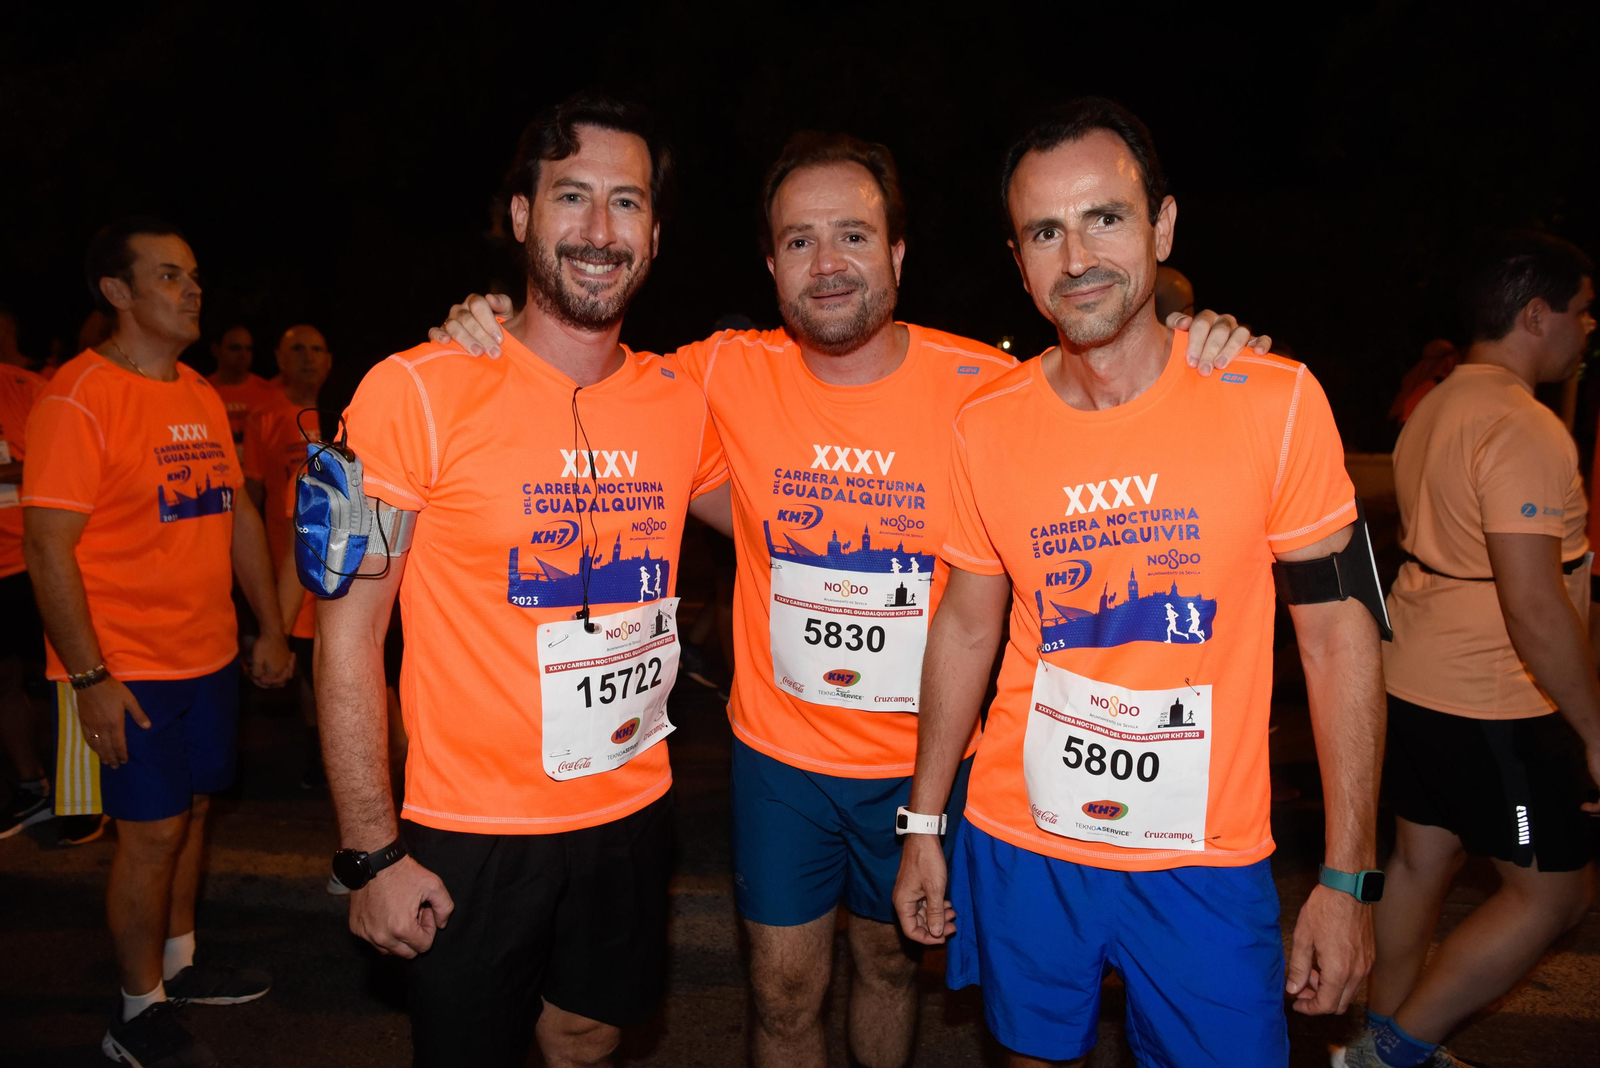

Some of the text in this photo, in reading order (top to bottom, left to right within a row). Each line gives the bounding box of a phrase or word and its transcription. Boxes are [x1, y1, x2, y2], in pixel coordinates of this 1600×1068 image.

[168, 423, 208, 442] XXXV
[154, 444, 190, 454] CARRERA
[810, 444, 896, 476] XXXV
[559, 449, 638, 478] XXXV
[522, 482, 664, 495] CARRERA NOCTURNA
[774, 468, 926, 493] CARRERA NOCTURNA
[535, 496, 665, 514] GUADALQUIVIR
[782, 483, 926, 510] GUADALQUIVIR
[1063, 473, 1158, 516] XXXV
[523, 497, 531, 515] DEL
[1030, 507, 1200, 539] CARRERA NOCTURNA
[1033, 540, 1041, 559] DEL
[1042, 524, 1201, 557] GUADALQUIVIR
[511, 596, 538, 605] 2023
[777, 596, 789, 604] XXXV
[790, 599, 813, 608] CARRERA
[813, 603, 843, 613] NOCTURNA
[803, 617, 886, 653] 5830
[567, 660, 595, 669] CARRERA
[595, 654, 624, 665] NOCTURNA
[576, 657, 662, 708] 15722
[874, 695, 914, 703] Cruzcampo
[1038, 705, 1053, 715] XXXV
[1052, 711, 1076, 725] CARRERA
[1076, 720, 1109, 735] NOCTURNA
[1109, 730, 1121, 738] DEL
[1121, 733, 1170, 741] GUADALQUIVIR
[1062, 735, 1160, 782] 5800
[1144, 830, 1193, 840] Cruzcampo
